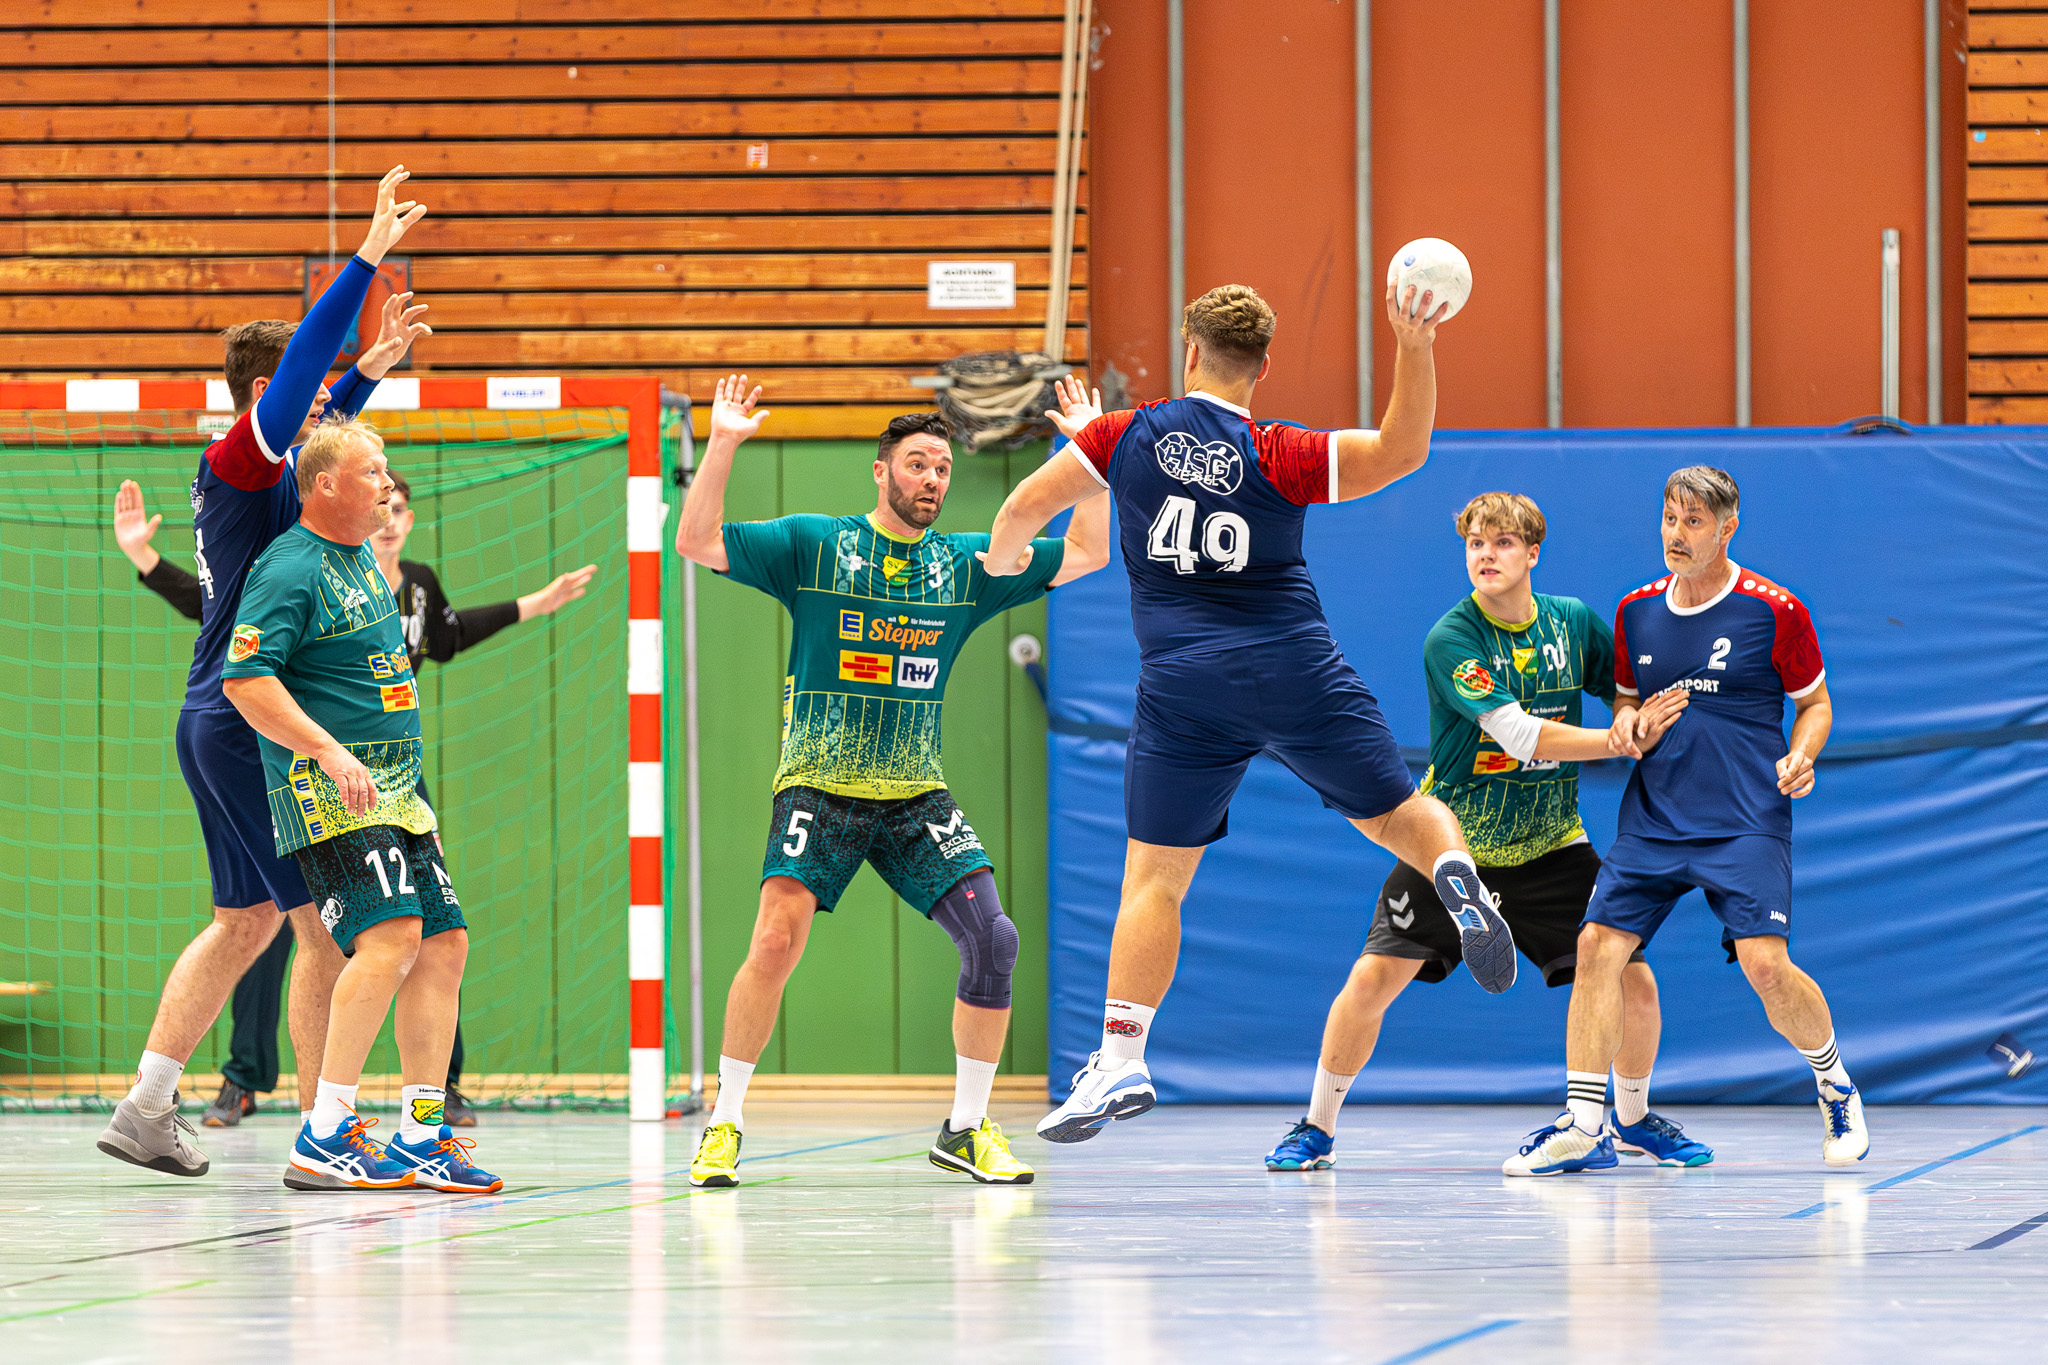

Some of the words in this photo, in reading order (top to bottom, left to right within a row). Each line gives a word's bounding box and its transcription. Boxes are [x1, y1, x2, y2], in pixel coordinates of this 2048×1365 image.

[1164, 444, 1232, 480] HSG
[1147, 494, 1250, 574] 49
[887, 560, 900, 569] SV
[868, 617, 944, 651] Stepper
[1542, 636, 1567, 671] 20
[1707, 636, 1732, 671] 2
[901, 661, 937, 683] R+V
[782, 810, 814, 858] 5
[364, 846, 416, 898] 12
[1769, 910, 1787, 925] JAKO
[1105, 1020, 1137, 1033] HSG
